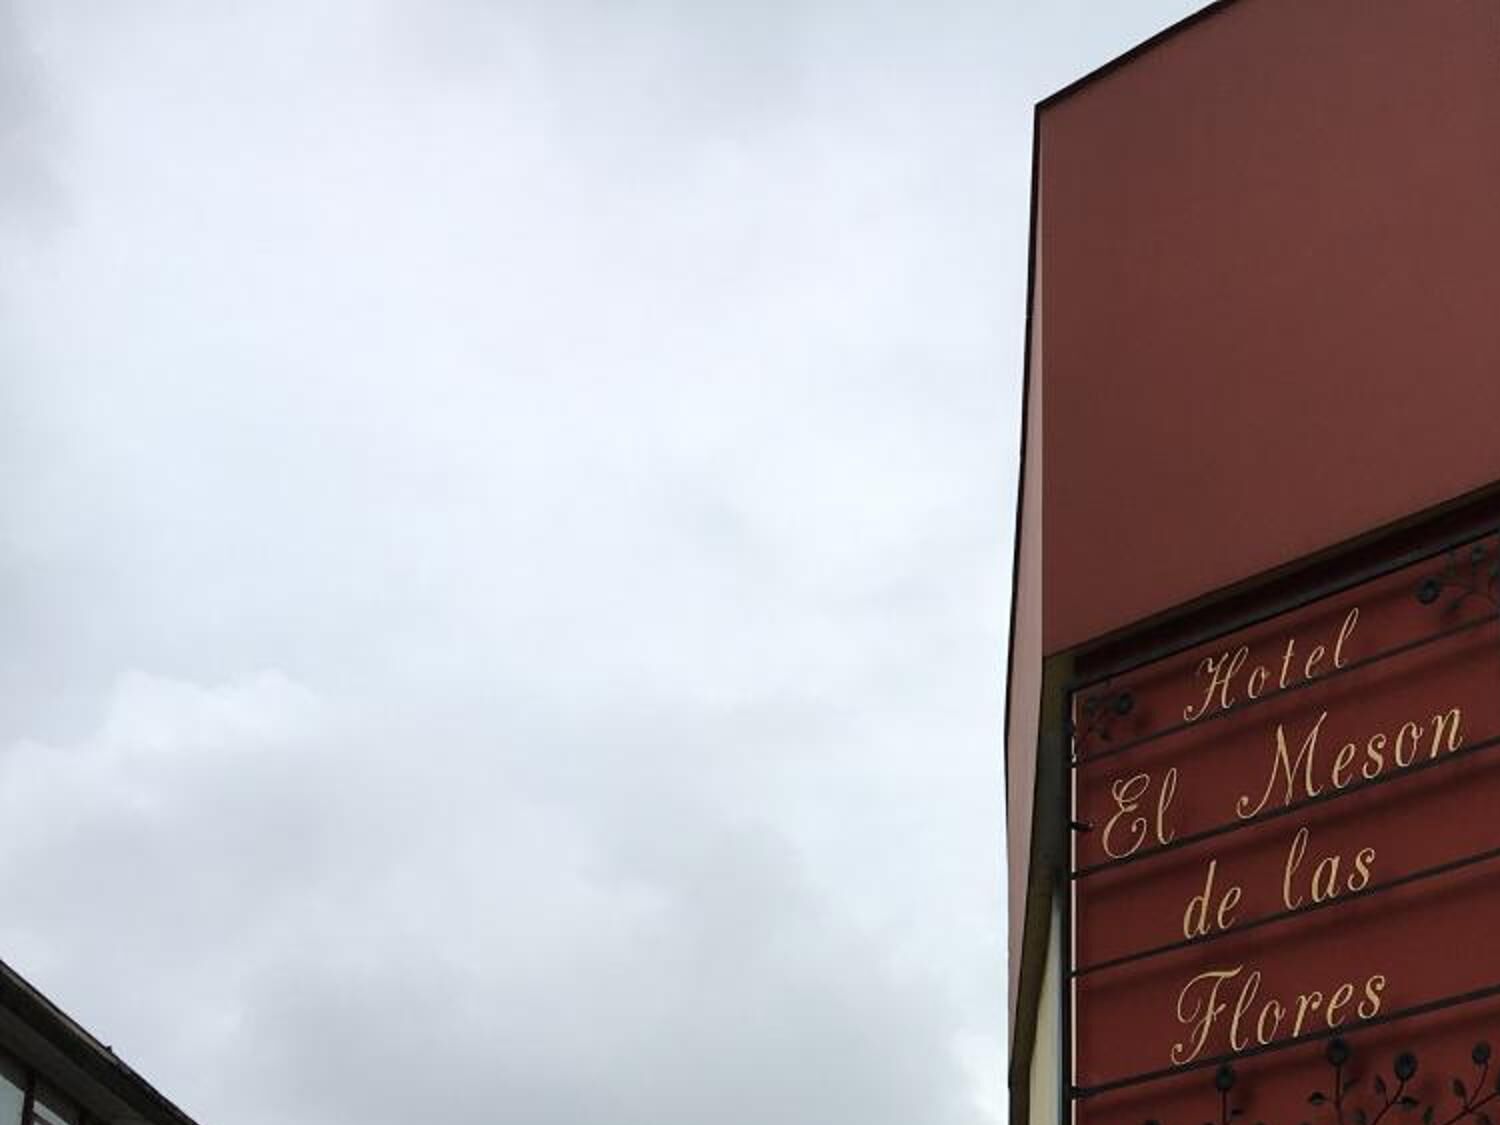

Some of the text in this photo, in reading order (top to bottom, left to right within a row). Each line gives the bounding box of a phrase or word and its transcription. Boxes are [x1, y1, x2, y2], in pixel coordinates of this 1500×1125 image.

[1183, 607, 1360, 722] Hotel
[1101, 708, 1463, 860] El Meson
[1183, 827, 1377, 940] de las
[1170, 964, 1387, 1066] Flores
